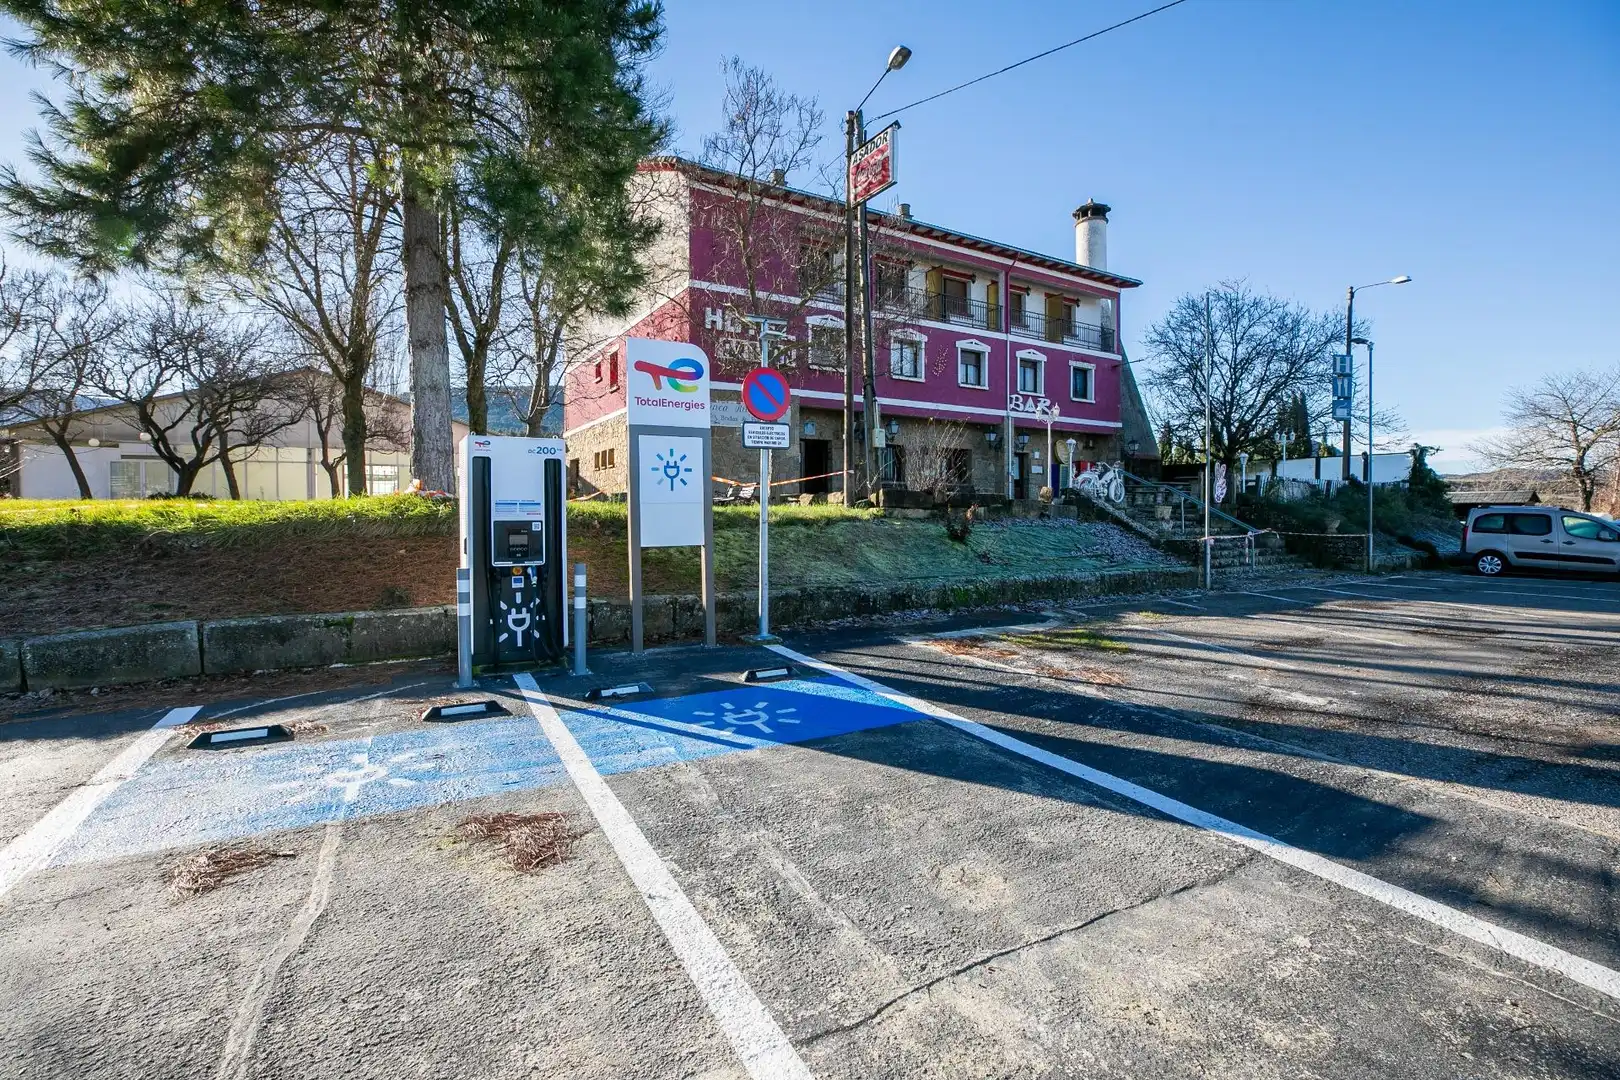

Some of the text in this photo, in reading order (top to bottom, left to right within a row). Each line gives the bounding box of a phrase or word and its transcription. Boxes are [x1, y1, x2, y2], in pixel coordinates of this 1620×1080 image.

[852, 130, 889, 165] ASADOR
[634, 396, 705, 411] TotalEnergies
[1009, 394, 1051, 415] BAR
